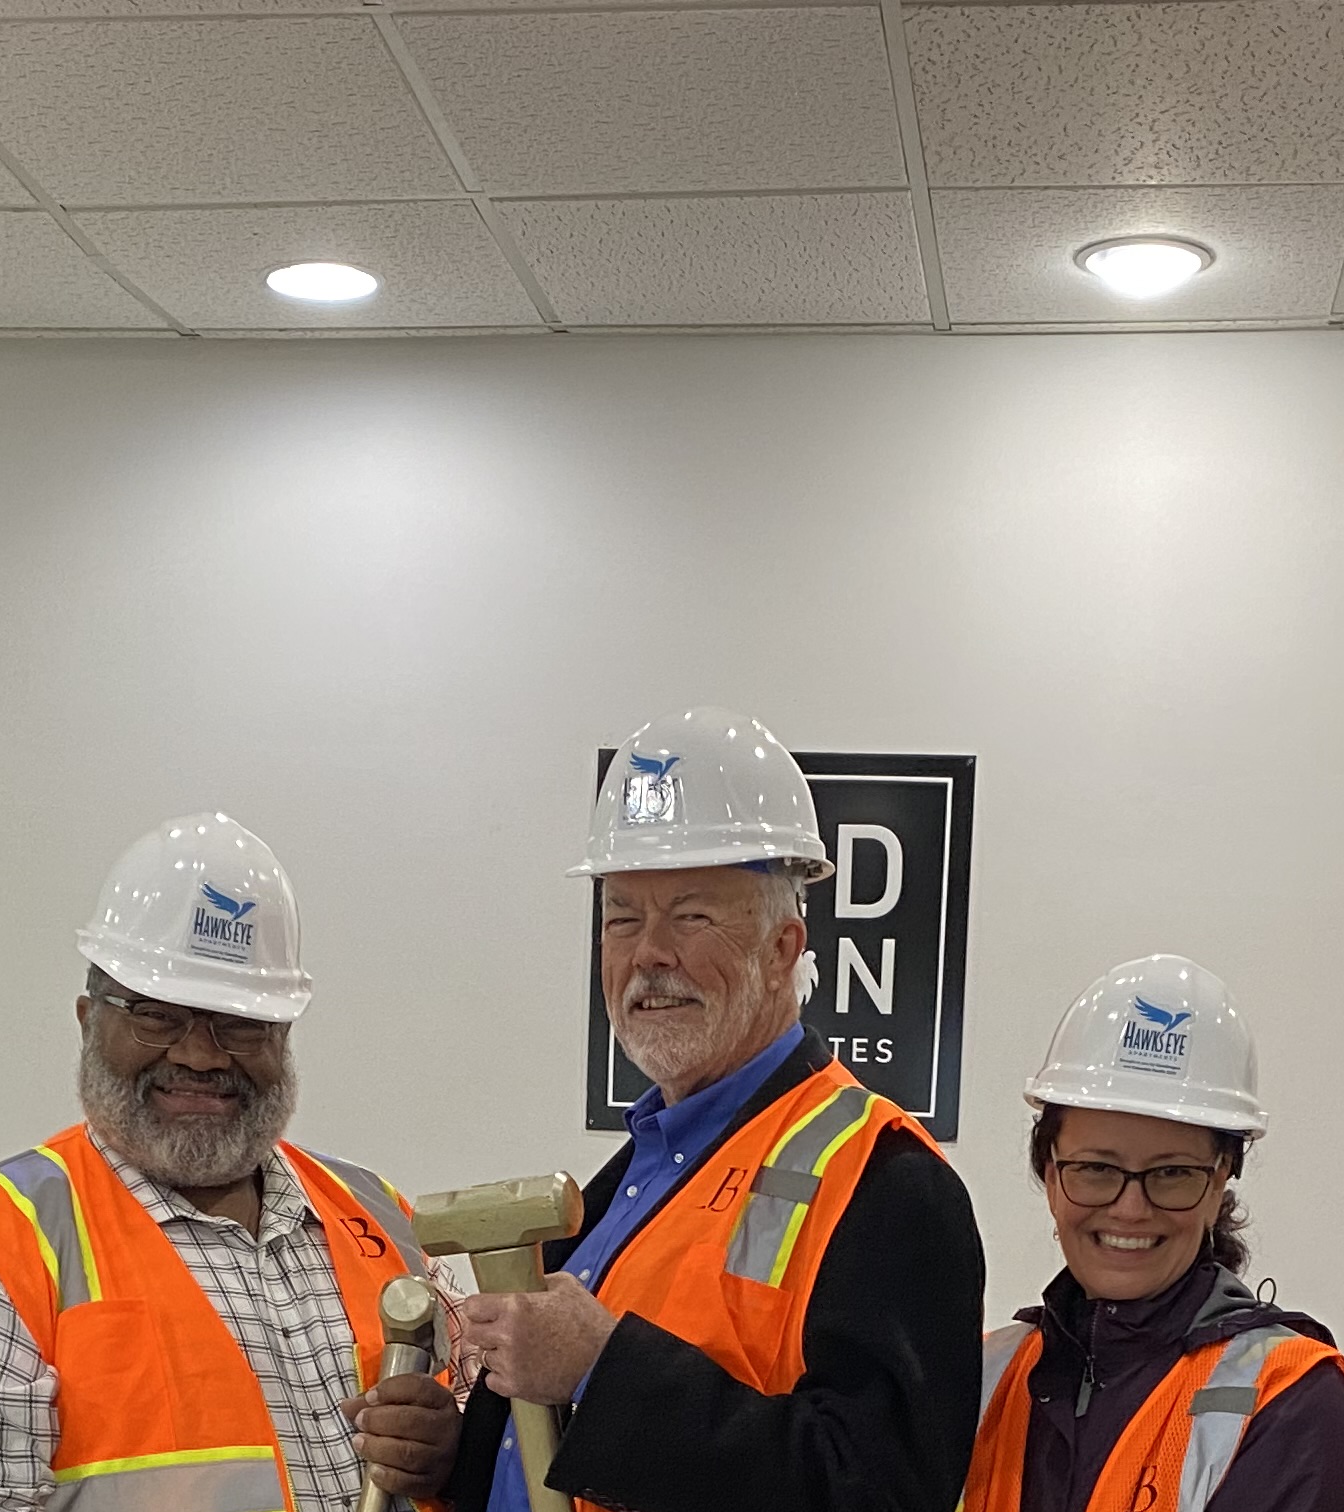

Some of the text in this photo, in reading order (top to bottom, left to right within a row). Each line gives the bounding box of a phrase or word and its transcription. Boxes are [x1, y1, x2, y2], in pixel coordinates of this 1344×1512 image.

[835, 824, 904, 919] D
[233, 921, 254, 946] EYE
[828, 1036, 894, 1064] TES
[1165, 1032, 1188, 1056] EYE
[337, 1216, 387, 1259] B
